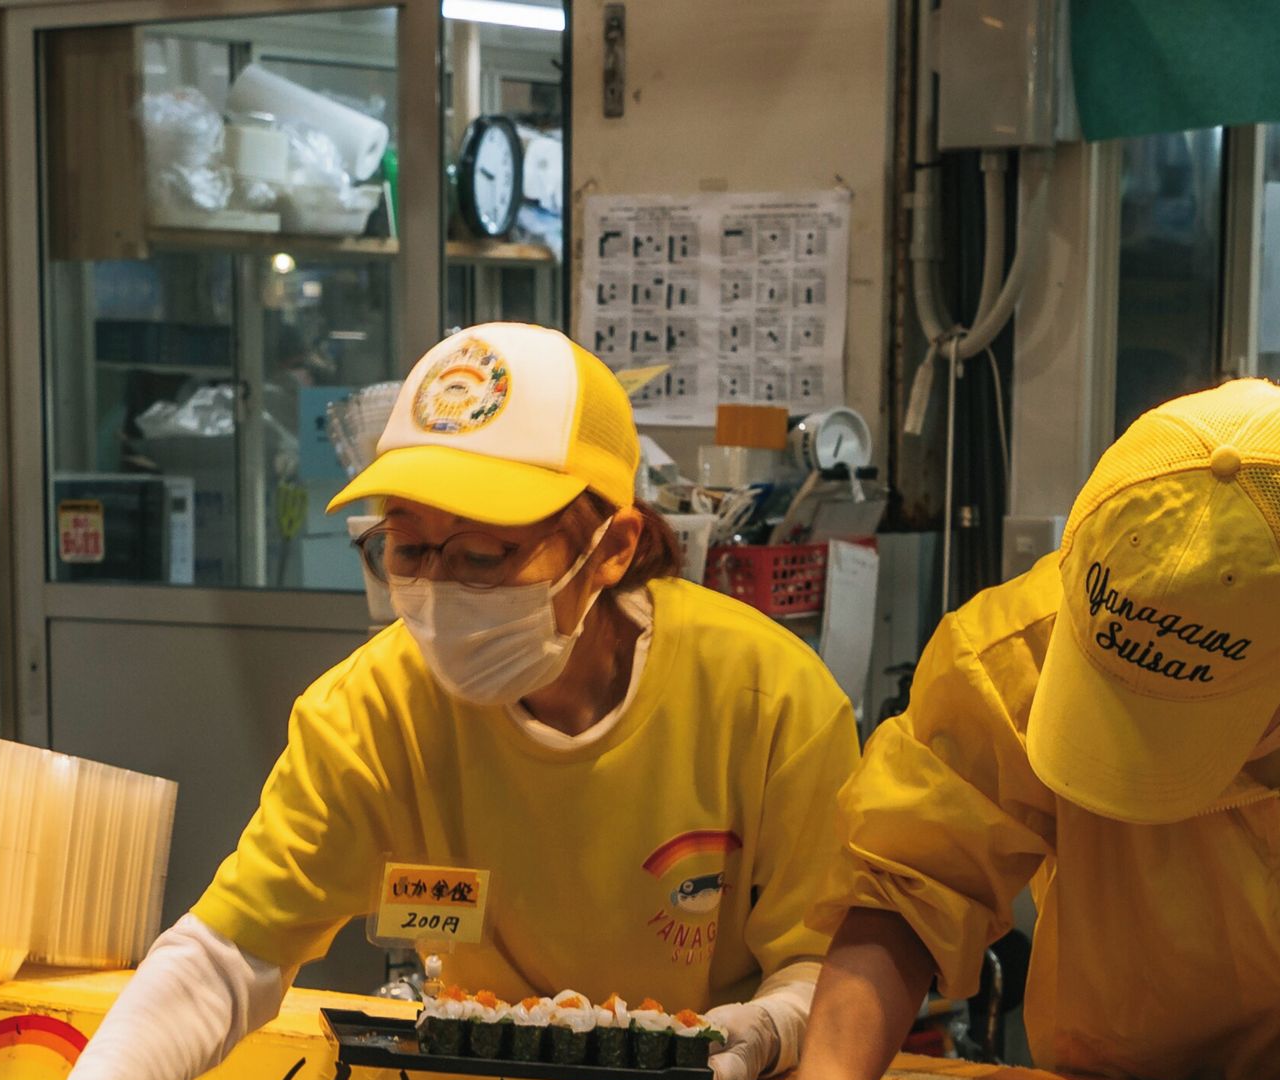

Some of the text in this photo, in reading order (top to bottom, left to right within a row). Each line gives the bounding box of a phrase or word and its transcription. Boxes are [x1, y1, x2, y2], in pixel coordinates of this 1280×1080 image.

[1085, 561, 1252, 661] Yanagawa
[1096, 621, 1214, 682] Suisan
[401, 912, 461, 934] 200円
